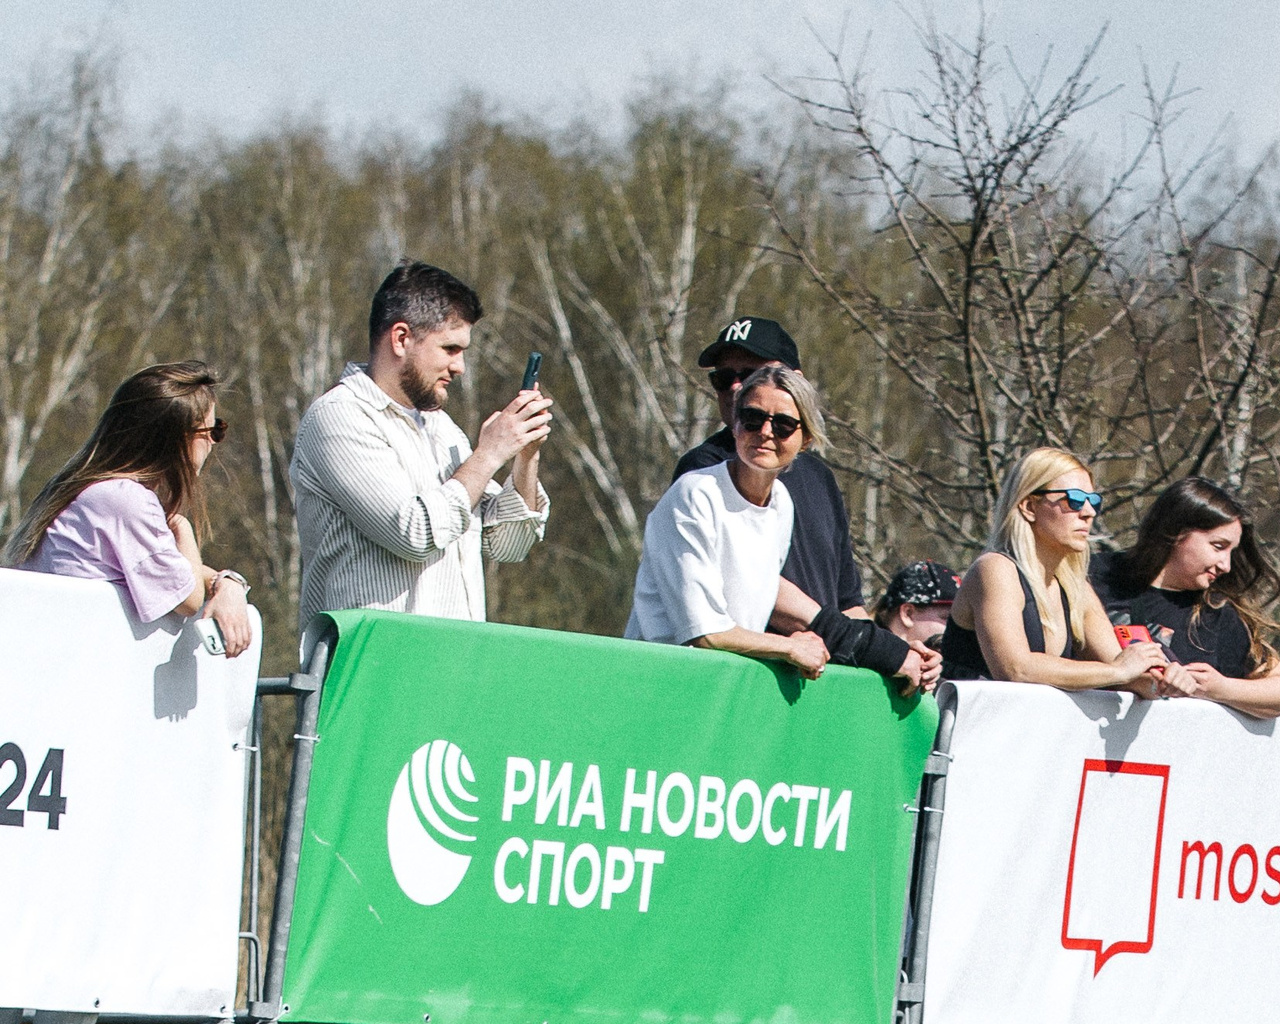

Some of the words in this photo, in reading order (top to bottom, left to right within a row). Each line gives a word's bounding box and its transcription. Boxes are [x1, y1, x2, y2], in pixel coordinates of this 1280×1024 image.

[725, 320, 753, 342] NY
[0, 742, 67, 830] 24
[501, 756, 606, 830] РИА
[620, 767, 852, 851] НОВОСТИ
[494, 836, 665, 913] СПОРТ
